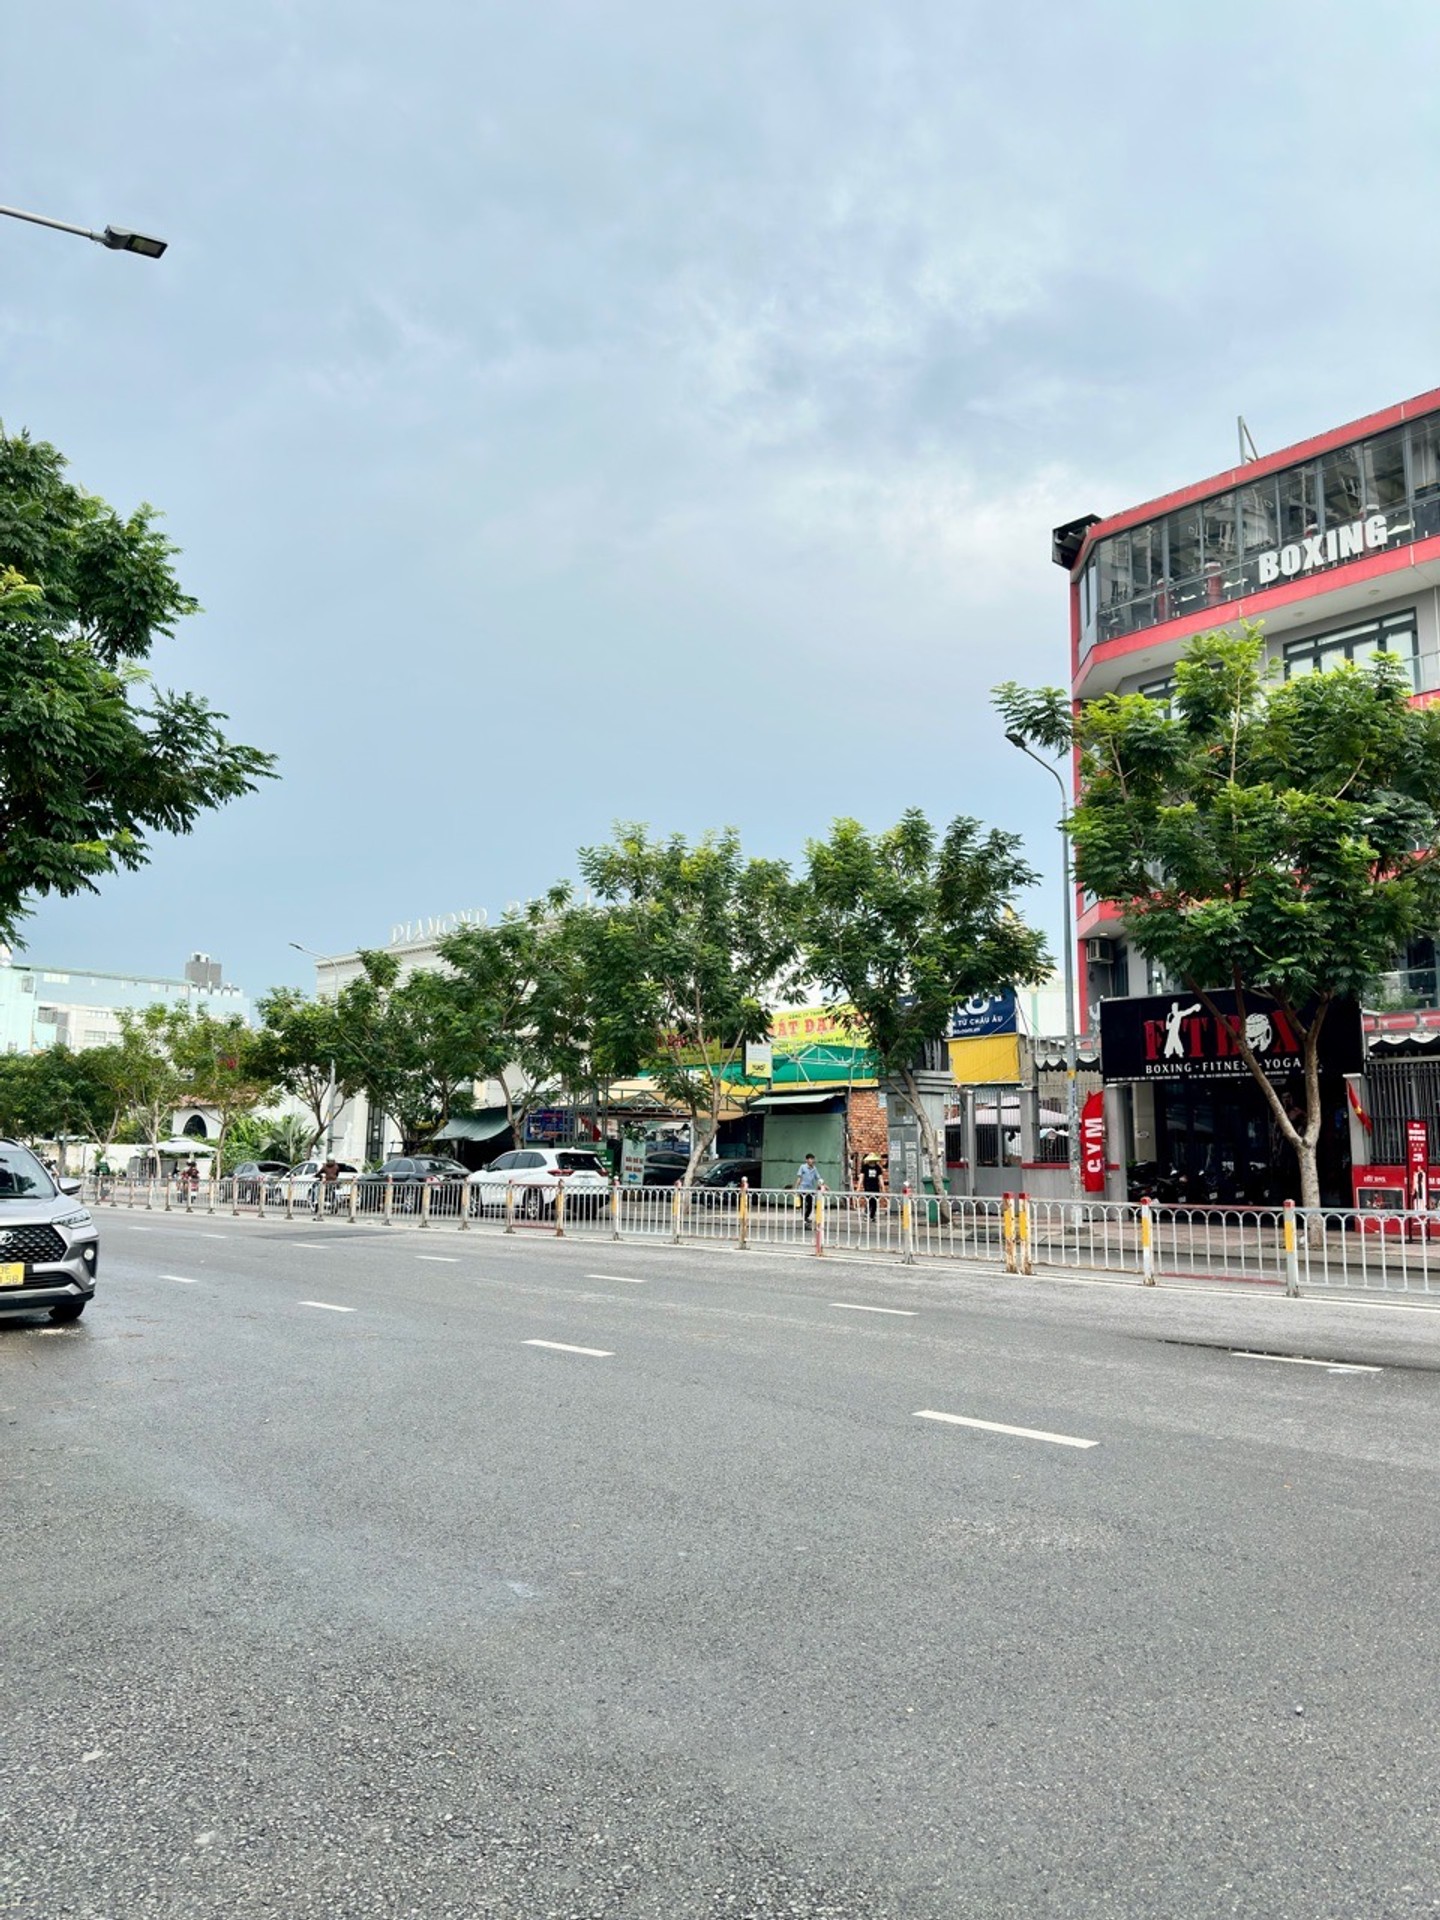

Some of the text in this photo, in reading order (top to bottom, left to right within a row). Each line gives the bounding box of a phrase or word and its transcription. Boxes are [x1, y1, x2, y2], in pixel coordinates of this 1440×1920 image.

[1258, 514, 1388, 585] BOXING
[1145, 1063, 1192, 1074] BOXING
[1264, 1057, 1302, 1069] YOGA
[1086, 1117, 1103, 1173] GYM
